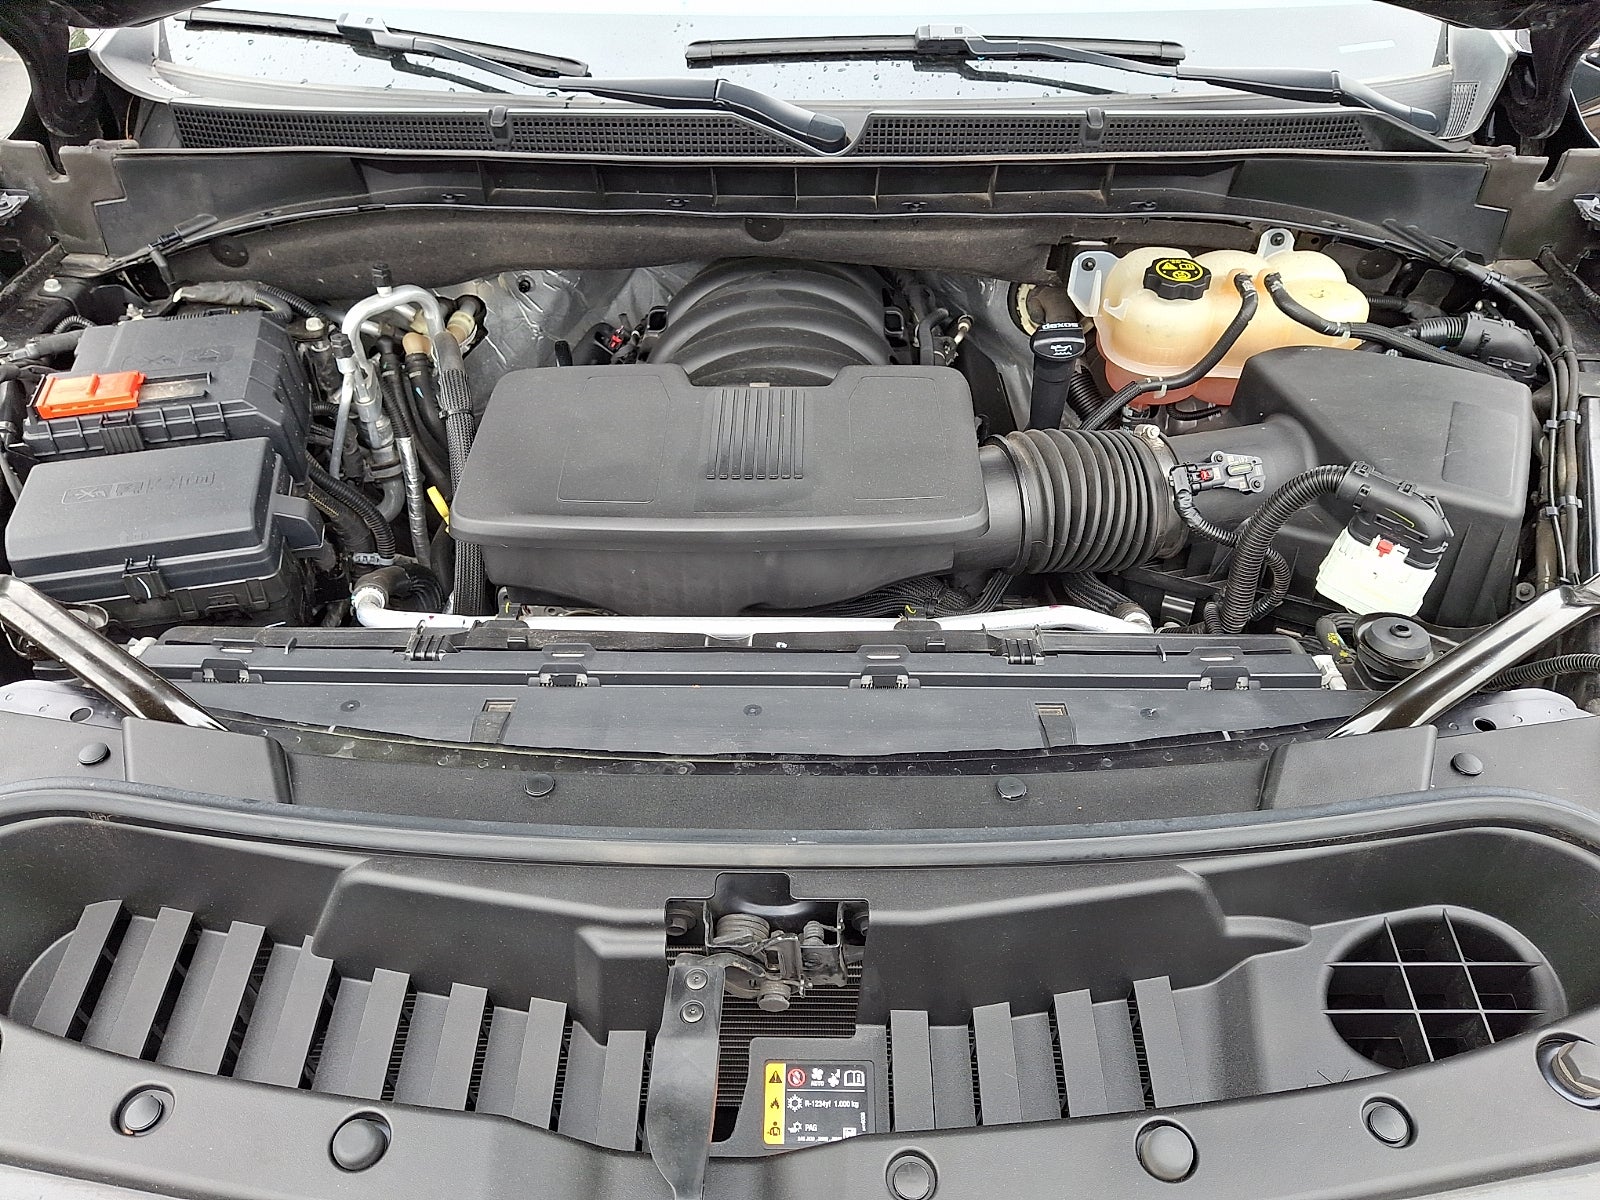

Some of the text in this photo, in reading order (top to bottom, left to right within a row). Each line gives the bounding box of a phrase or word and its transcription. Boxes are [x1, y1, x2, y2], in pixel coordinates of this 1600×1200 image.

[1042, 322, 1079, 330] dexos
[804, 1100, 831, 1109] R-1234yf
[804, 1123, 818, 1132] PAG
